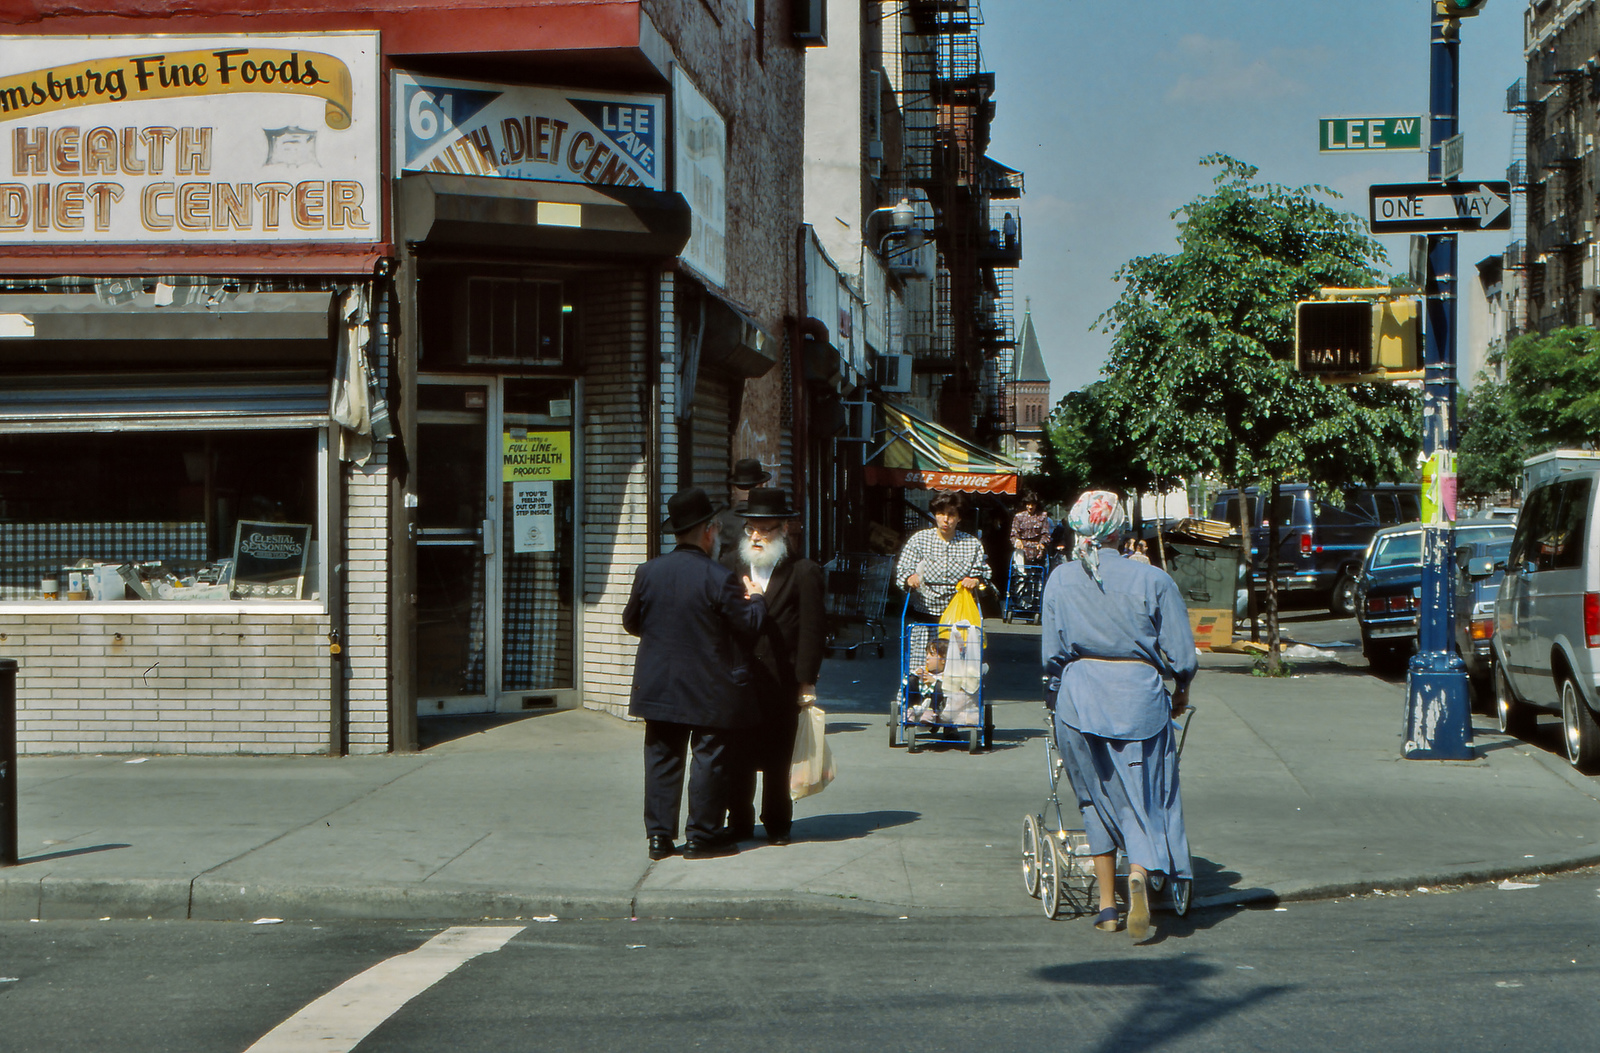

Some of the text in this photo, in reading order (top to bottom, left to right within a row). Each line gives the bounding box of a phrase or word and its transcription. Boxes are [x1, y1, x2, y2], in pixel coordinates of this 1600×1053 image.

[130, 55, 209, 91] Fine
[213, 48, 330, 85] Foods
[409, 91, 452, 139] 61
[603, 106, 649, 134] LEE
[500, 115, 568, 166] DIET
[1328, 119, 1414, 149] LEE AV
[12, 126, 213, 176] HEALTH
[0, 181, 371, 232] DIET CENTER
[1381, 196, 1492, 218] ONE WAY
[503, 453, 562, 465] MAXI-HEALTH
[508, 444, 528, 453] FULL
[531, 443, 552, 452] LINE
[513, 467, 551, 477] PRODUCTS
[905, 473, 990, 487] SELF SERVICE
[240, 540, 302, 556] SEASONINGS
[250, 532, 296, 544] CELESTIAL
